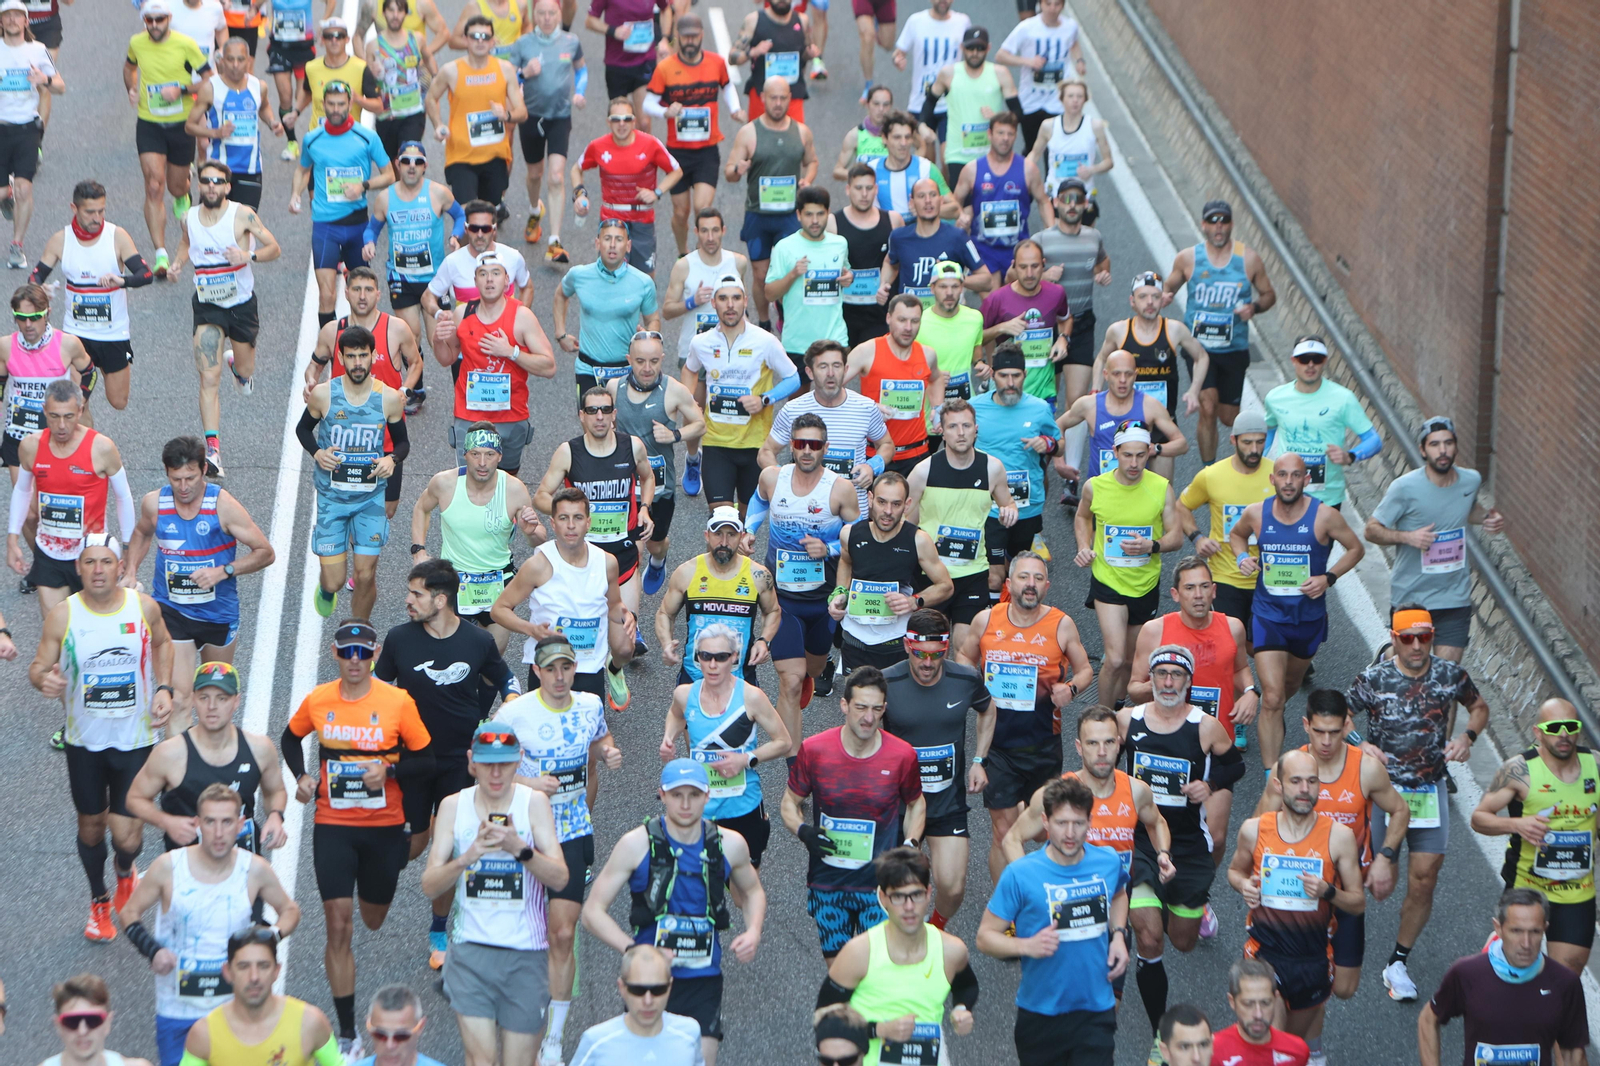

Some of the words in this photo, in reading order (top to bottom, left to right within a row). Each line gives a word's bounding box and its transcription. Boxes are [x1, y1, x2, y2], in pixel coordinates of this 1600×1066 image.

[410, 212, 431, 222] ULSA
[391, 229, 432, 241] ATLETISMO
[1136, 367, 1158, 376] KROCK
[21, 390, 44, 399] MEJO
[52, 498, 77, 506] ZURICH
[1262, 543, 1311, 552] TROTASIERRA
[703, 602, 750, 614] MOVIJEREZ
[84, 658, 96, 669] OS
[98, 655, 137, 668] GALGOS
[986, 655, 1046, 666] COSLADA
[1150, 653, 1192, 669] PRESSPO
[1002, 666, 1030, 675] ZURICH
[100, 675, 130, 684] ZURICH
[357, 742, 378, 750] TEAM
[920, 750, 948, 758] ZURICH
[559, 758, 584, 767] ZURICH
[1153, 759, 1183, 770] ZURICH
[920, 765, 938, 773] 3049
[836, 821, 867, 831] ZURICH
[485, 861, 516, 870] ZURICH
[1281, 858, 1314, 869] ZURICH
[1070, 885, 1100, 898] ZURICH
[1498, 1050, 1532, 1060] ZURICH
